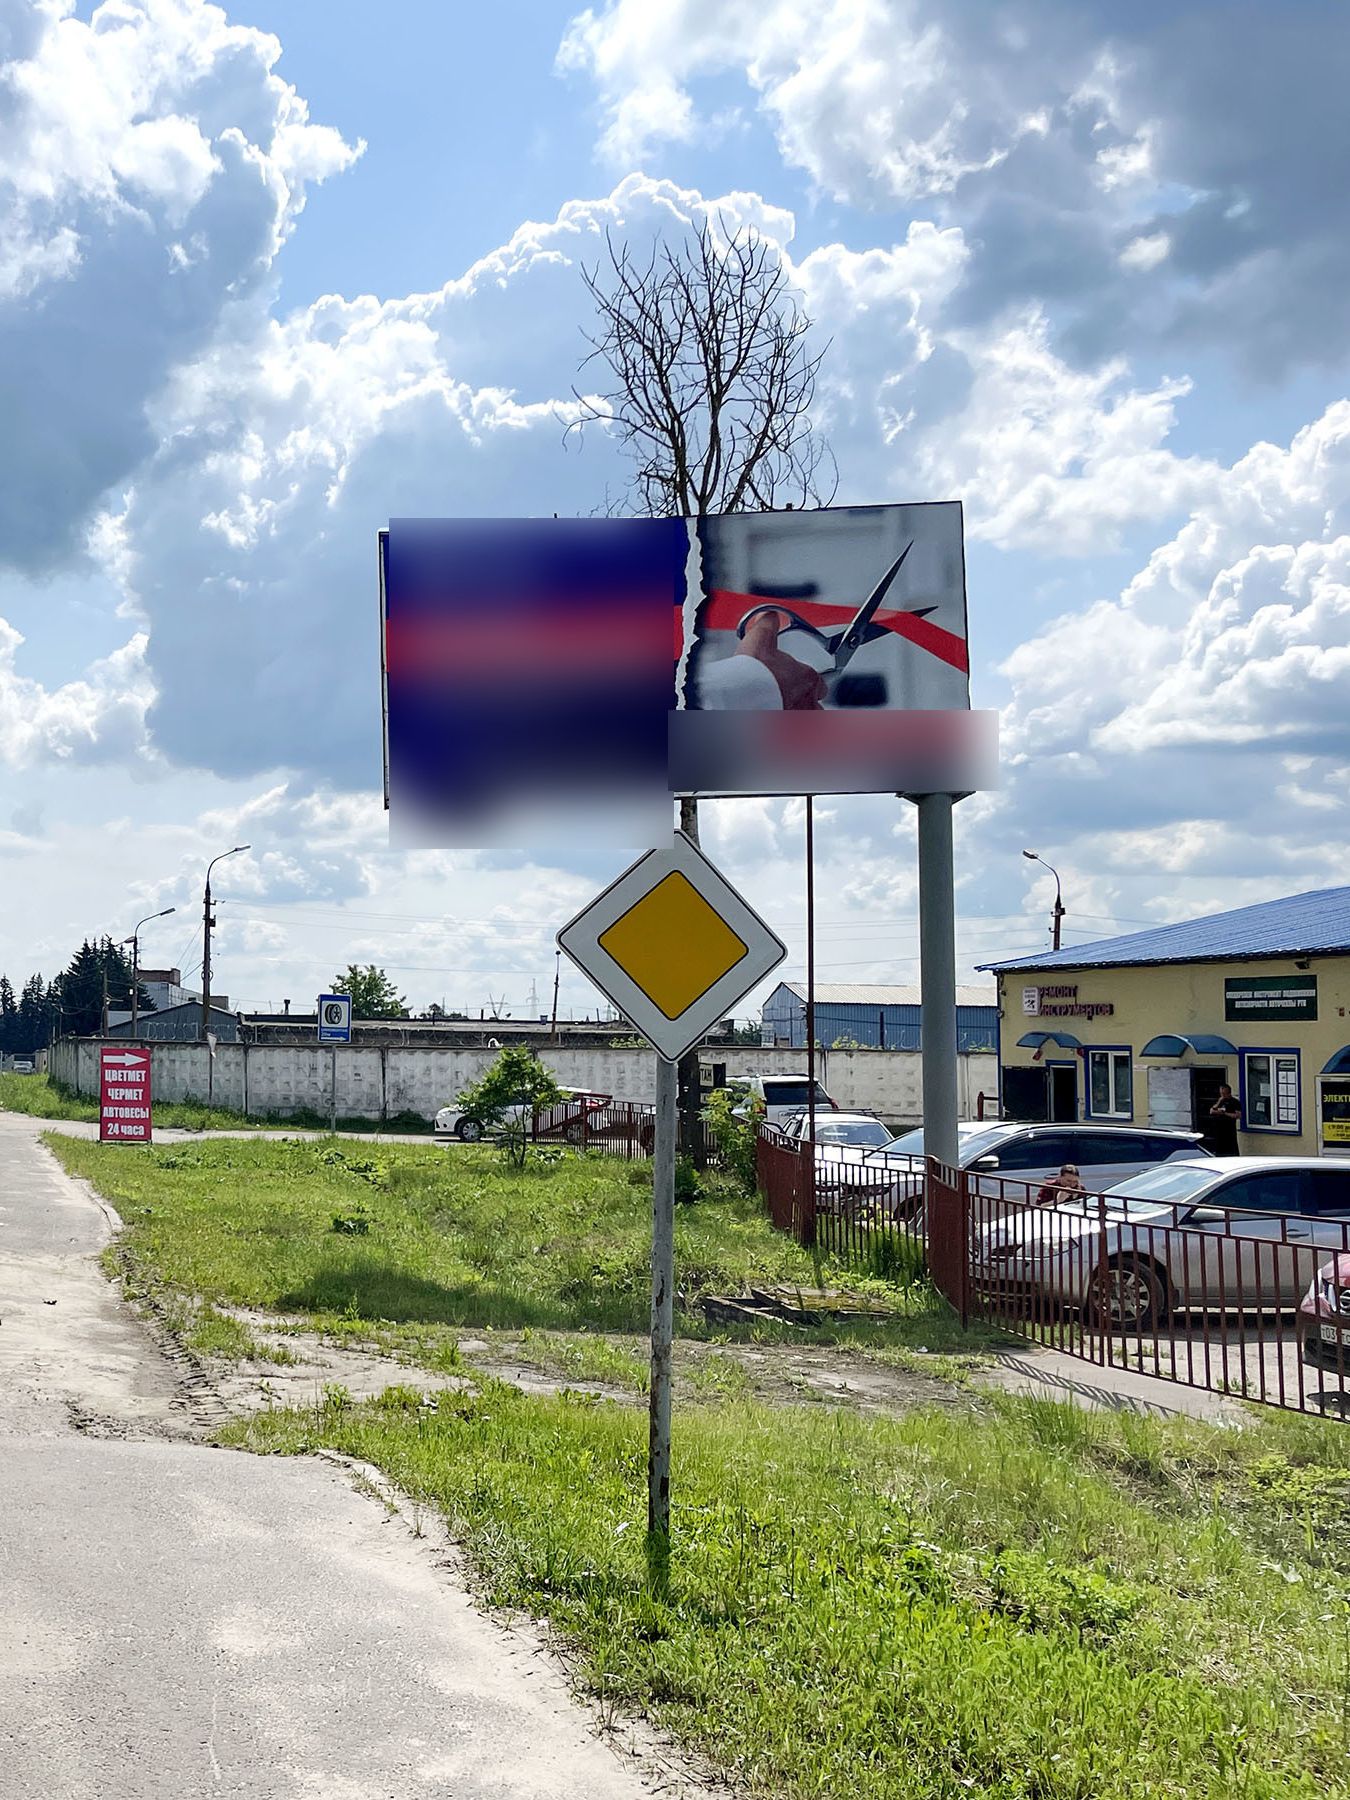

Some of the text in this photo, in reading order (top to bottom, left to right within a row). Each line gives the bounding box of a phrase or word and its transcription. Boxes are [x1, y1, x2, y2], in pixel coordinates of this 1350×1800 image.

[104, 1069, 147, 1082] ЦВЕТМЕТ
[107, 1087, 144, 1101] ЧЕРМЕТ
[103, 1106, 150, 1119] АВТОВЕСЫ
[107, 1123, 145, 1136] 24 часа
